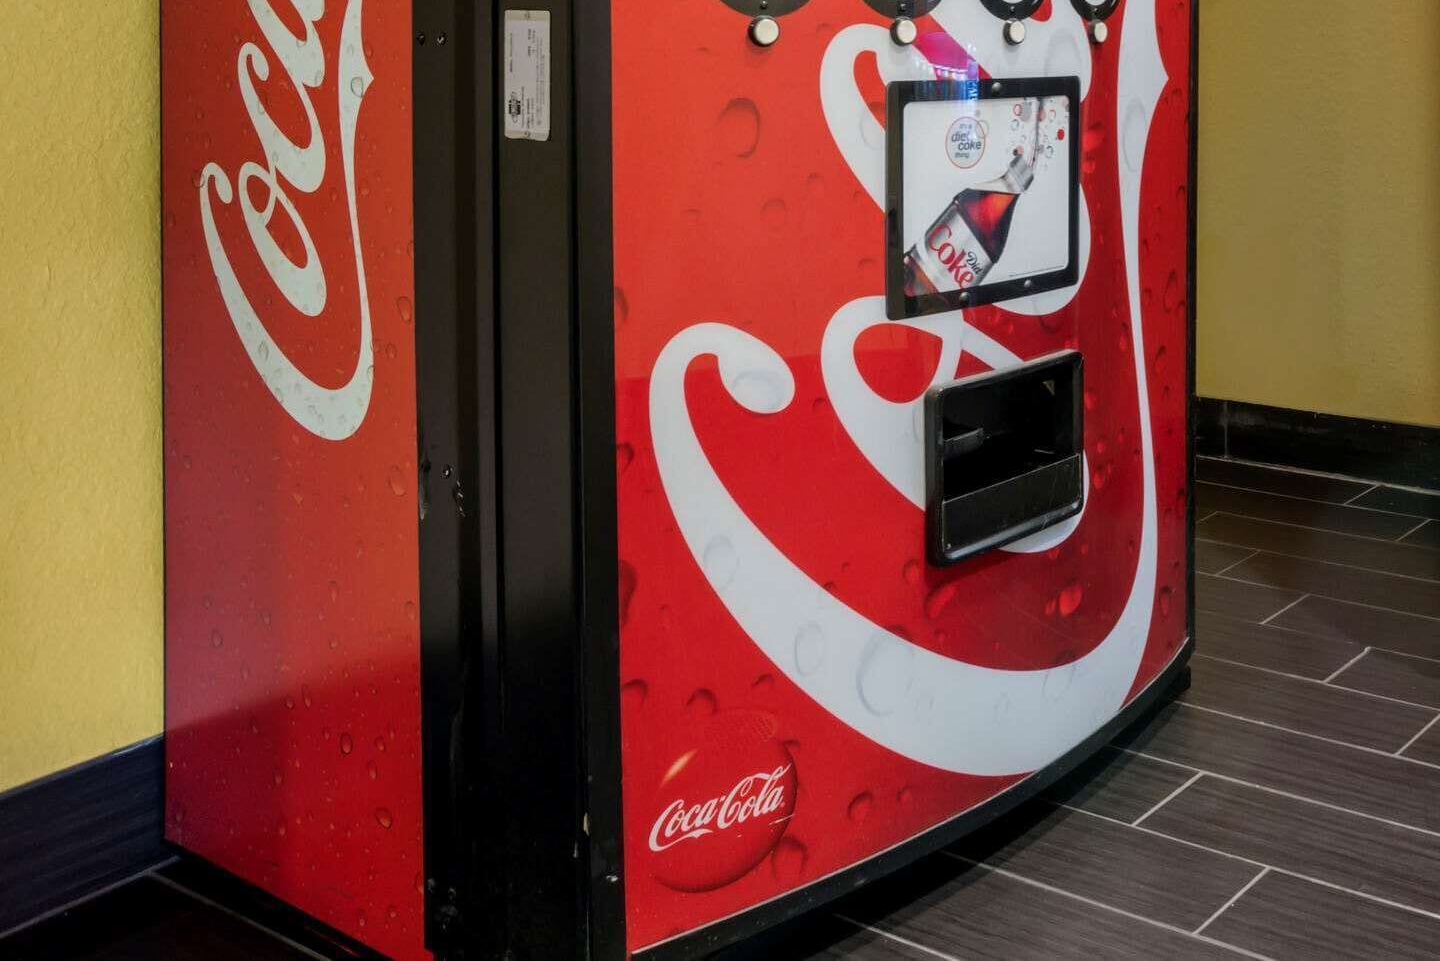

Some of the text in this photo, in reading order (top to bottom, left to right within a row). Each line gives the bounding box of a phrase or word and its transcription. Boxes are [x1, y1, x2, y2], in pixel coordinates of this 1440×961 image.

[958, 140, 982, 150] coke
[928, 223, 976, 289] Coke
[966, 251, 984, 275] Diet
[648, 762, 793, 853] Coca-Cola
